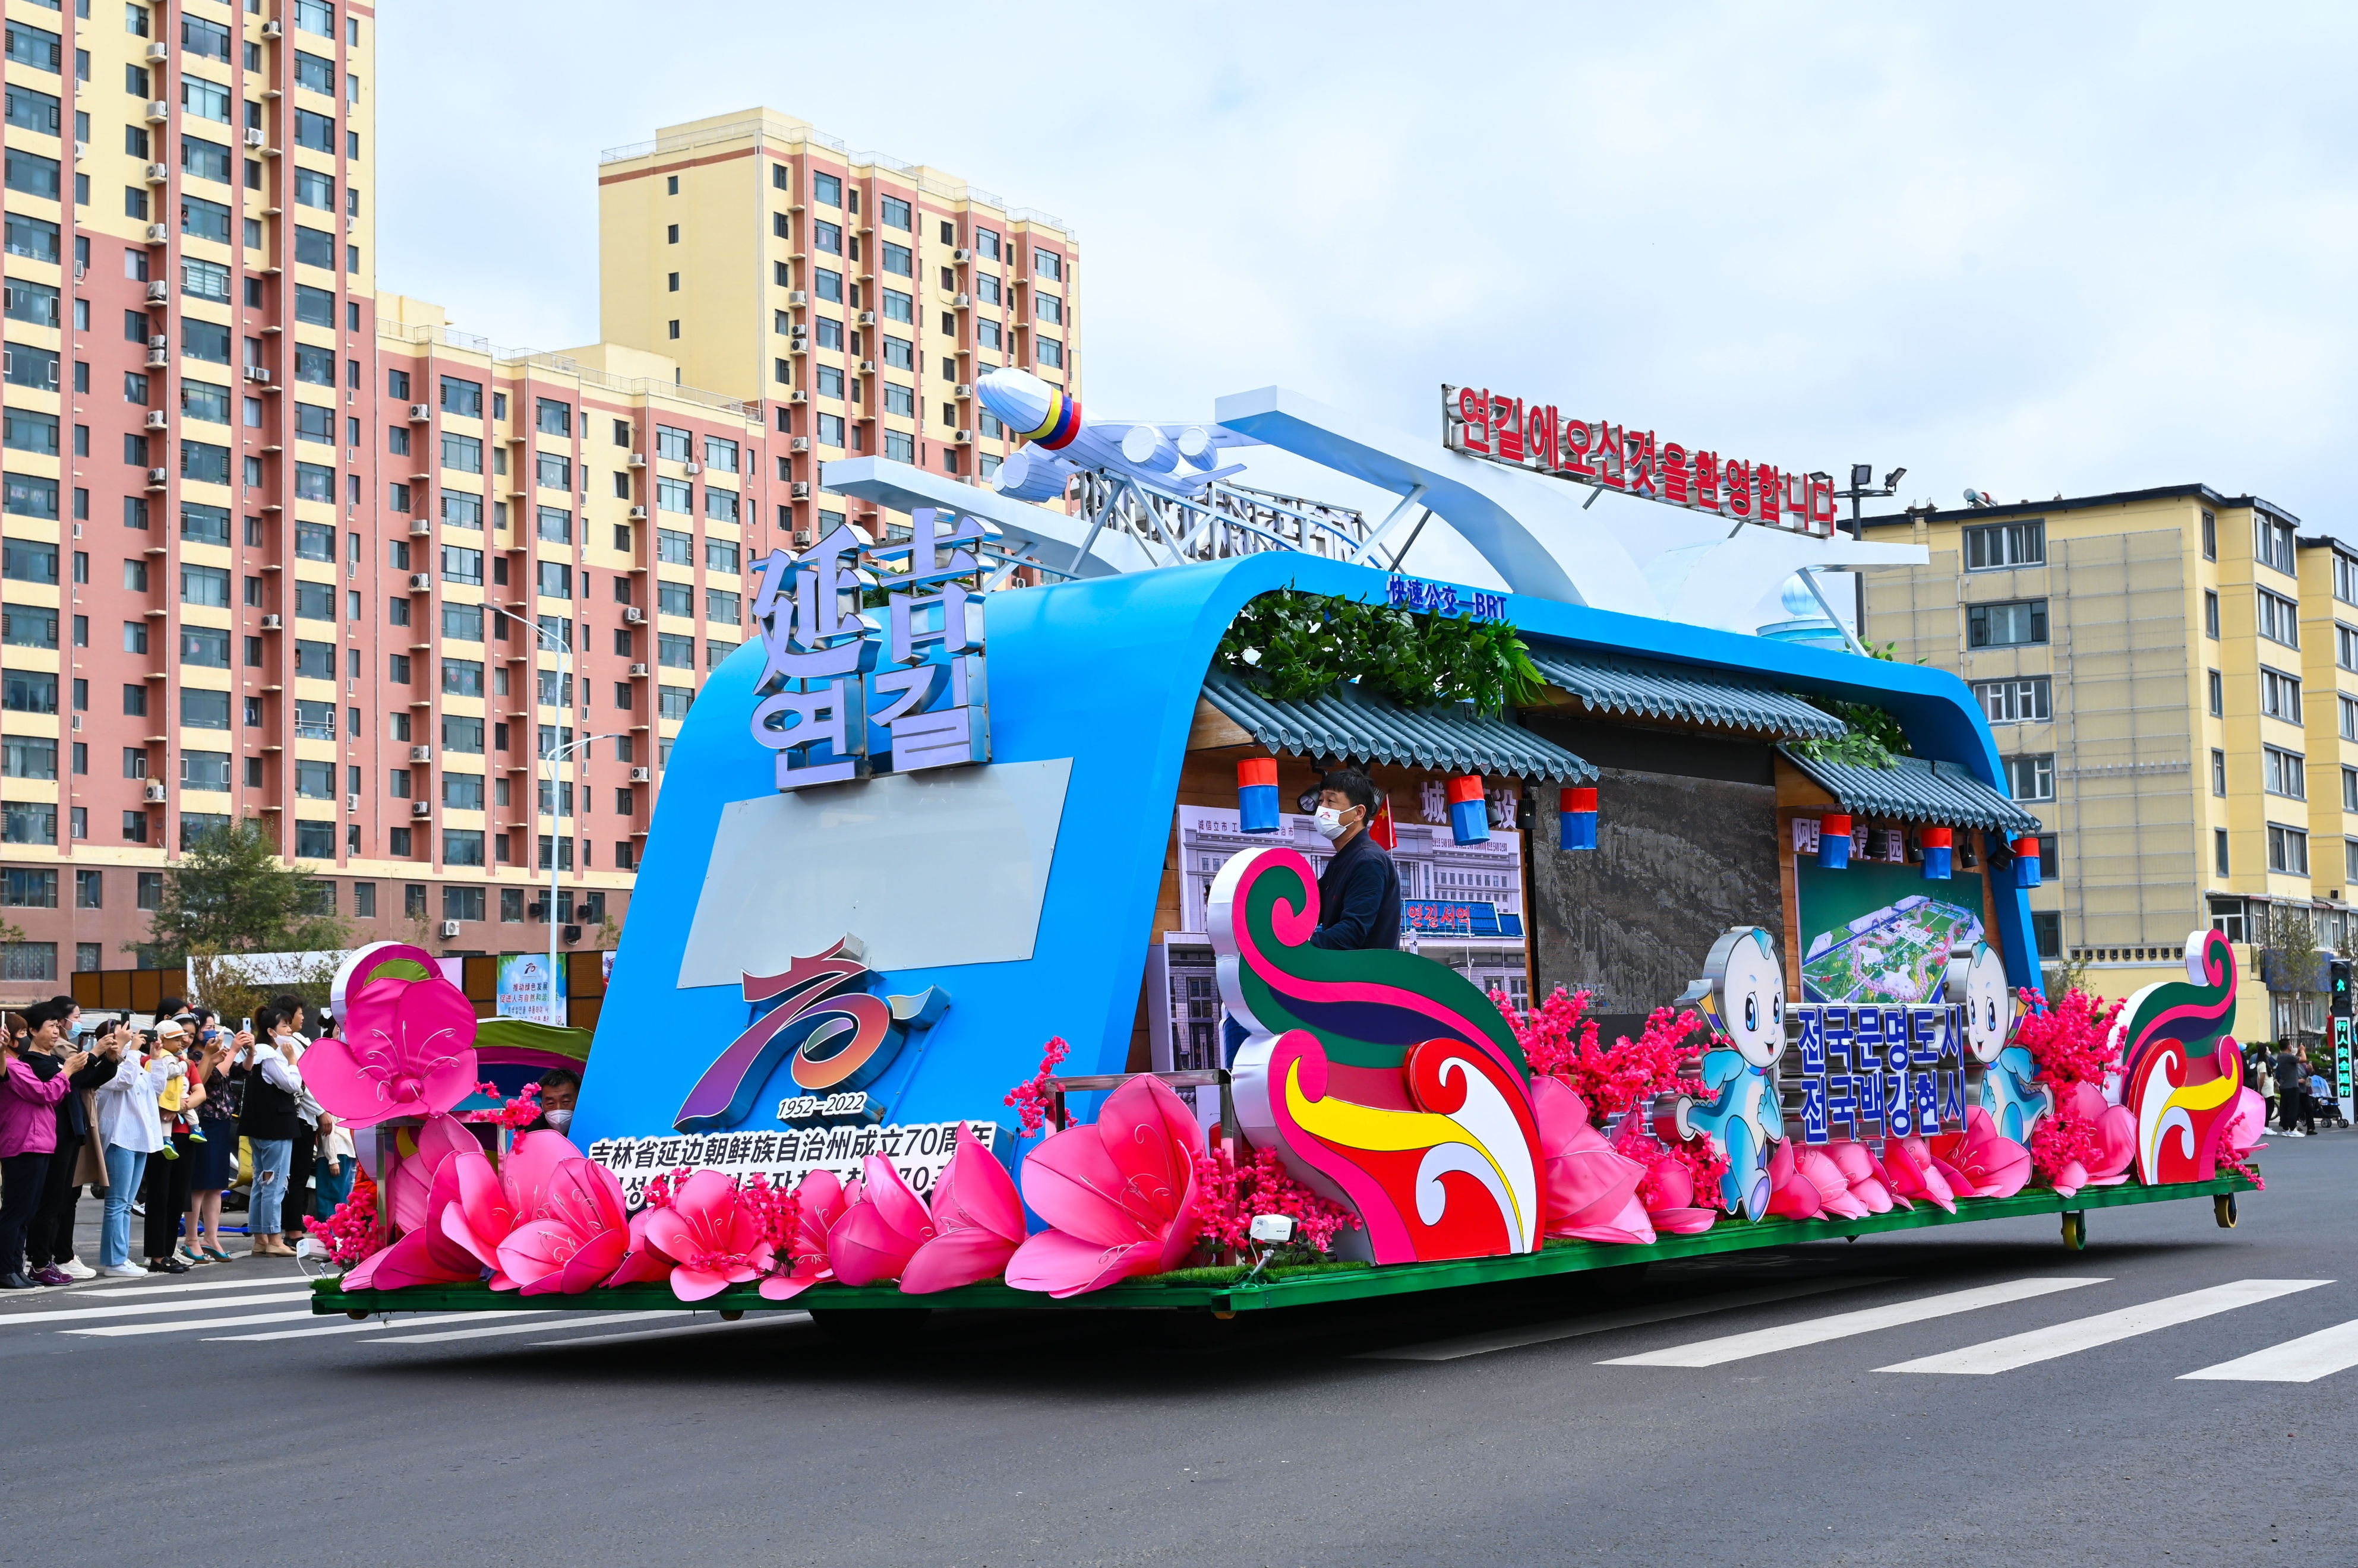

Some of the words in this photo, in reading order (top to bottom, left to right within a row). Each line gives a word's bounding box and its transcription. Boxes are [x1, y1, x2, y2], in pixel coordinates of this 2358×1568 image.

[749, 507, 993, 696] 延吉
[750, 657, 977, 790] 연길
[1421, 780, 1518, 830] 城设
[513, 982, 548, 992] 推动绿色发展
[1798, 1005, 1964, 1074] 전국문명도시
[2337, 1021, 2351, 1096] 行人安全通行
[779, 1094, 864, 1117] 1952-2022
[1800, 1069, 1967, 1143] 전국백강현시
